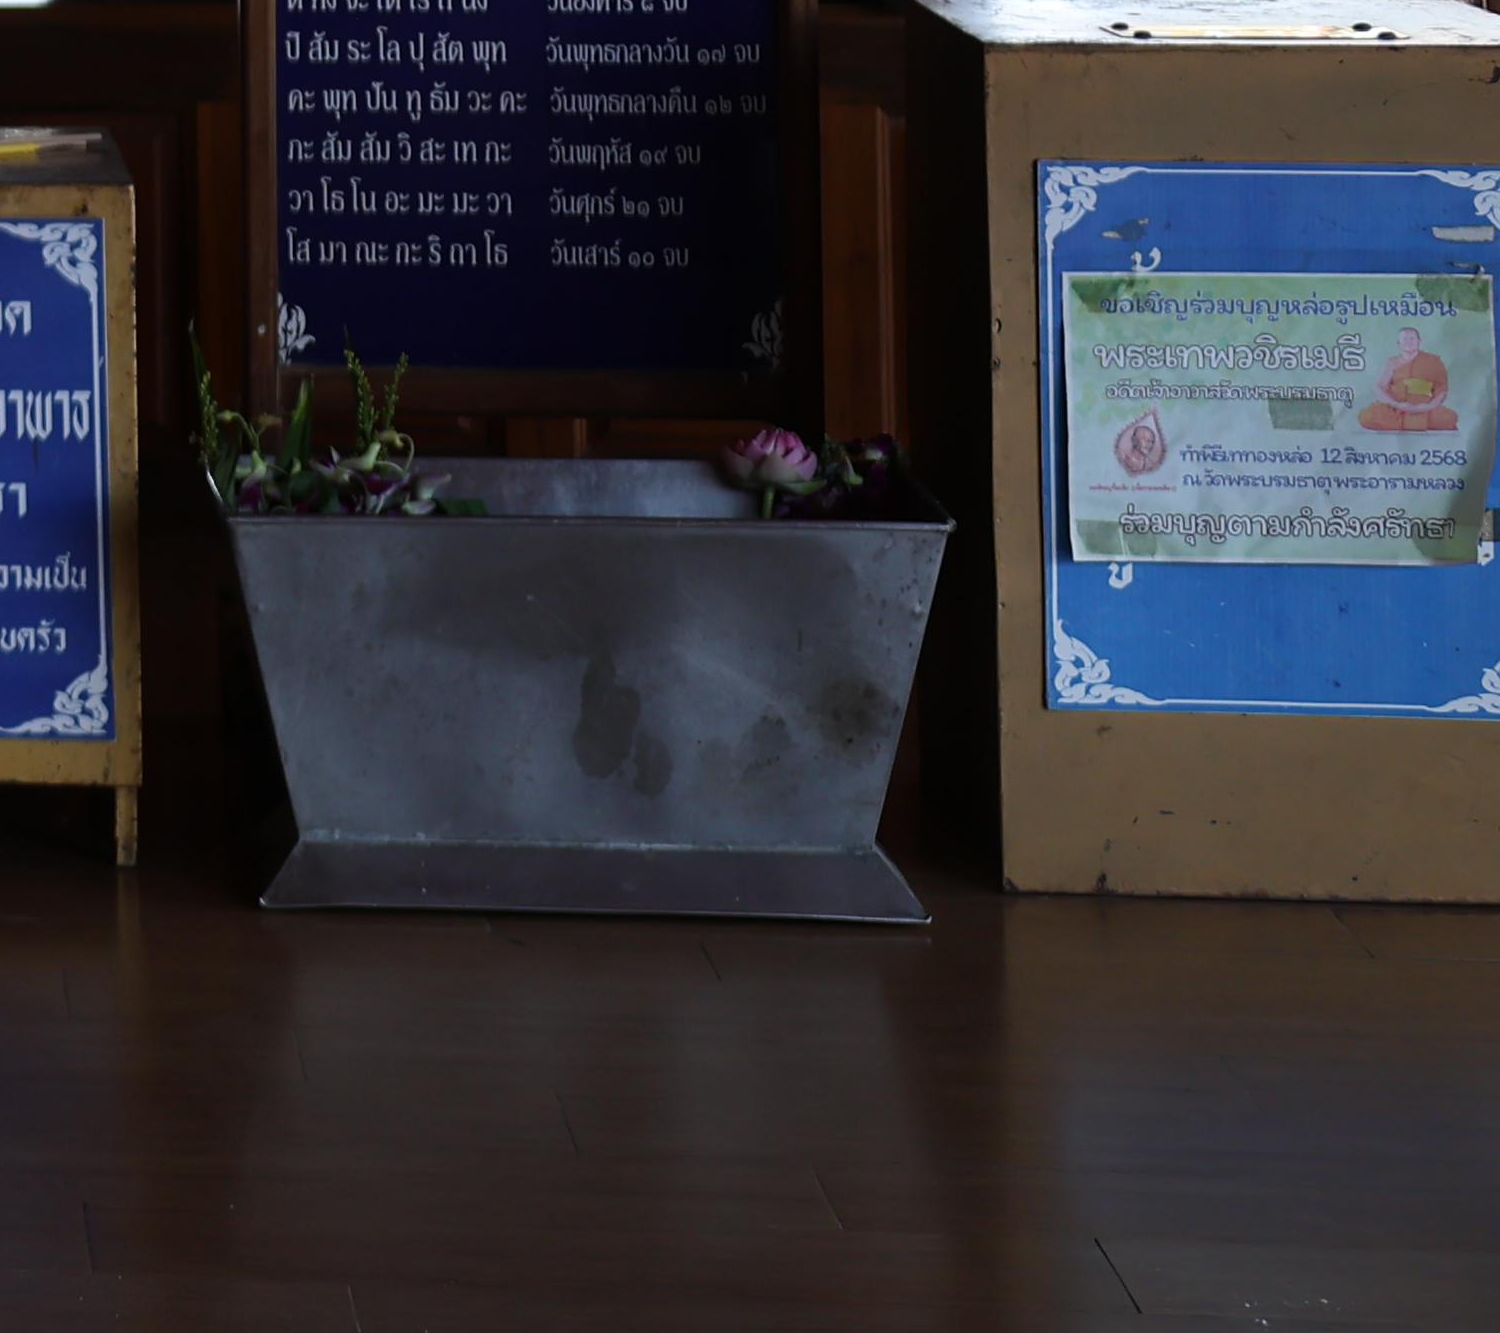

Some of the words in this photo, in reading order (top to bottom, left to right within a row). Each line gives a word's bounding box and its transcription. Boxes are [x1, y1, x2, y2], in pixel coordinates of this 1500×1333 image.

[308, 31, 339, 62] สัม
[347, 38, 371, 61] ระ
[376, 25, 401, 62] โล
[409, 32, 425, 72] ปุ
[432, 30, 464, 62] สัต
[472, 40, 507, 72] พุท
[545, 35, 690, 70] วันพุทธกลางวัน
[697, 43, 726, 64] ๑๗
[733, 43, 760, 64] จบ
[288, 88, 315, 112] คะ
[323, 88, 357, 120] พุท
[365, 81, 397, 112] ปัน
[406, 90, 422, 121] ทู
[429, 80, 459, 111] ธัม
[467, 90, 491, 111] วะ
[499, 90, 527, 113] คะ
[550, 85, 697, 121] วันพุทธกลางคืน
[704, 94, 732, 114] ๑๒
[740, 94, 766, 114] จบ
[321, 130, 352, 161] สัม
[360, 130, 391, 161] สัม
[397, 132, 412, 162] วิ
[419, 136, 446, 162] สะ
[453, 139, 477, 162] เท
[548, 136, 632, 170] วันพฤหัส
[675, 144, 701, 165] จบ
[288, 189, 314, 212] วา
[320, 176, 345, 213] โธ
[350, 175, 377, 212] โน
[384, 191, 410, 213] อะ
[418, 190, 445, 213] มะ
[452, 191, 479, 213] มะ
[486, 192, 513, 215] วา
[549, 187, 615, 222] วันศุกร์
[621, 196, 650, 218] ๒๑
[657, 196, 684, 216] จบ
[286, 226, 311, 264] โส
[319, 240, 347, 264] มา
[395, 242, 422, 265] กะ
[428, 233, 442, 264] ริ
[483, 229, 508, 266] โธ
[550, 238, 621, 266] วันเสาร์
[628, 251, 655, 268] ๑๐
[663, 246, 689, 267] จบ
[1099, 289, 1458, 325] ขอเชิญร่วมบุญหล่อรูปเหมือน
[1092, 332, 1367, 373] พระเทพวชิรเมธี
[1321, 447, 1342, 464] 12
[1344, 445, 1417, 467] สิงหาคม
[1420, 448, 1469, 466] 2568
[1182, 472, 1202, 487] ณ
[1119, 504, 1457, 546] ร่วมบุญตามกำลังศรัทธา
